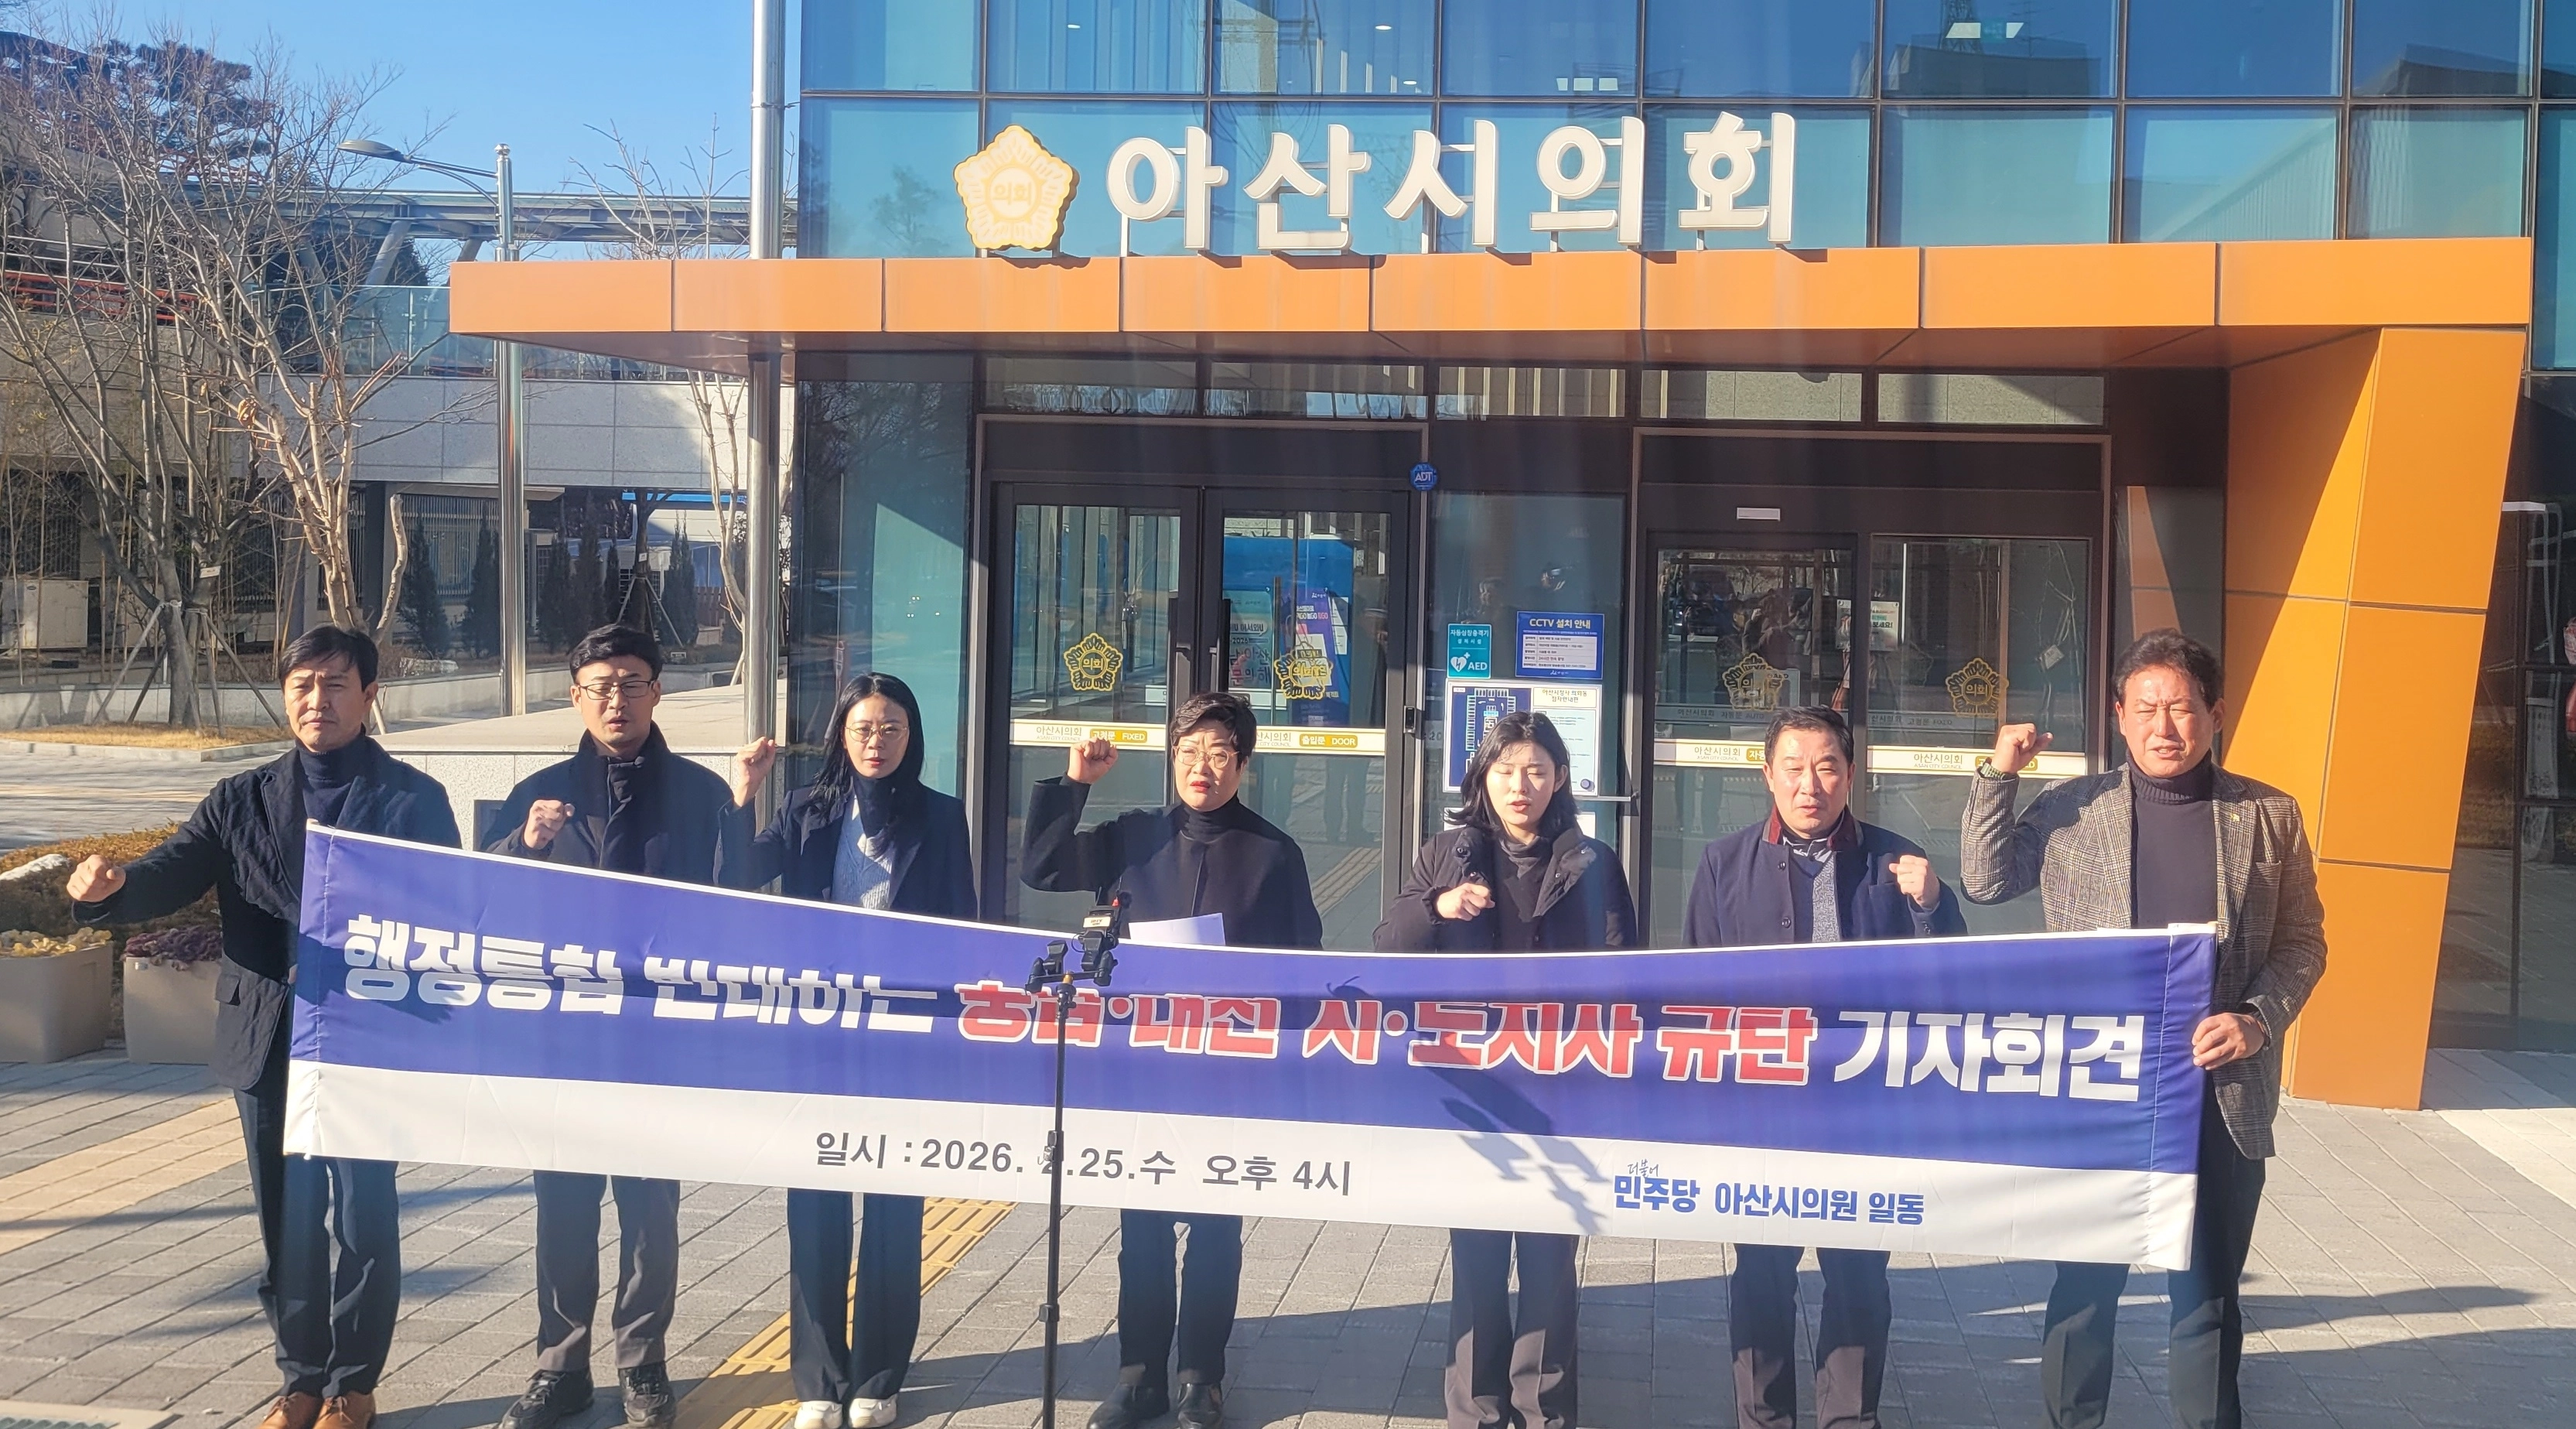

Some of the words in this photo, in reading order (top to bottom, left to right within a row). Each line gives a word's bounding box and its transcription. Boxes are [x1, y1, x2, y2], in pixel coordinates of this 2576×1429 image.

[1106, 111, 1796, 251] 아산시의회
[992, 182, 1033, 207] 의회
[1414, 471, 1433, 482] ADT
[1529, 618, 1555, 627] CCTV
[1556, 618, 1573, 629] 설치
[1574, 620, 1591, 630] 안내
[1450, 629, 1489, 638] 자동심장충격기
[1083, 657, 1104, 671] 의회
[1467, 662, 1488, 670] AED
[1966, 683, 1988, 697] 의회
[1036, 726, 1082, 737] 아산시의회
[1122, 732, 1146, 741] FIXED
[1256, 732, 1292, 743] 산시의회
[1302, 735, 1326, 745] 출입문
[1331, 737, 1356, 746] DOOR
[1694, 746, 1741, 757] 아산시의회
[1914, 753, 1963, 764] 아산시의회
[343, 914, 625, 1015] 행정통합
[644, 956, 938, 1034] 반대하는
[1301, 1000, 1645, 1079] 시·도지사
[1655, 1004, 1819, 1086] 규탄
[1833, 1010, 2145, 1103] 기자회견
[816, 1132, 887, 1170] 일시
[1202, 1155, 1278, 1191] 오후
[1292, 1160, 1351, 1197] 4시
[1627, 1158, 1659, 1178] 더불어
[1614, 1174, 1701, 1213] 민주당
[1714, 1181, 1858, 1222] 아산시의원
[1867, 1192, 1925, 1226] 일동
